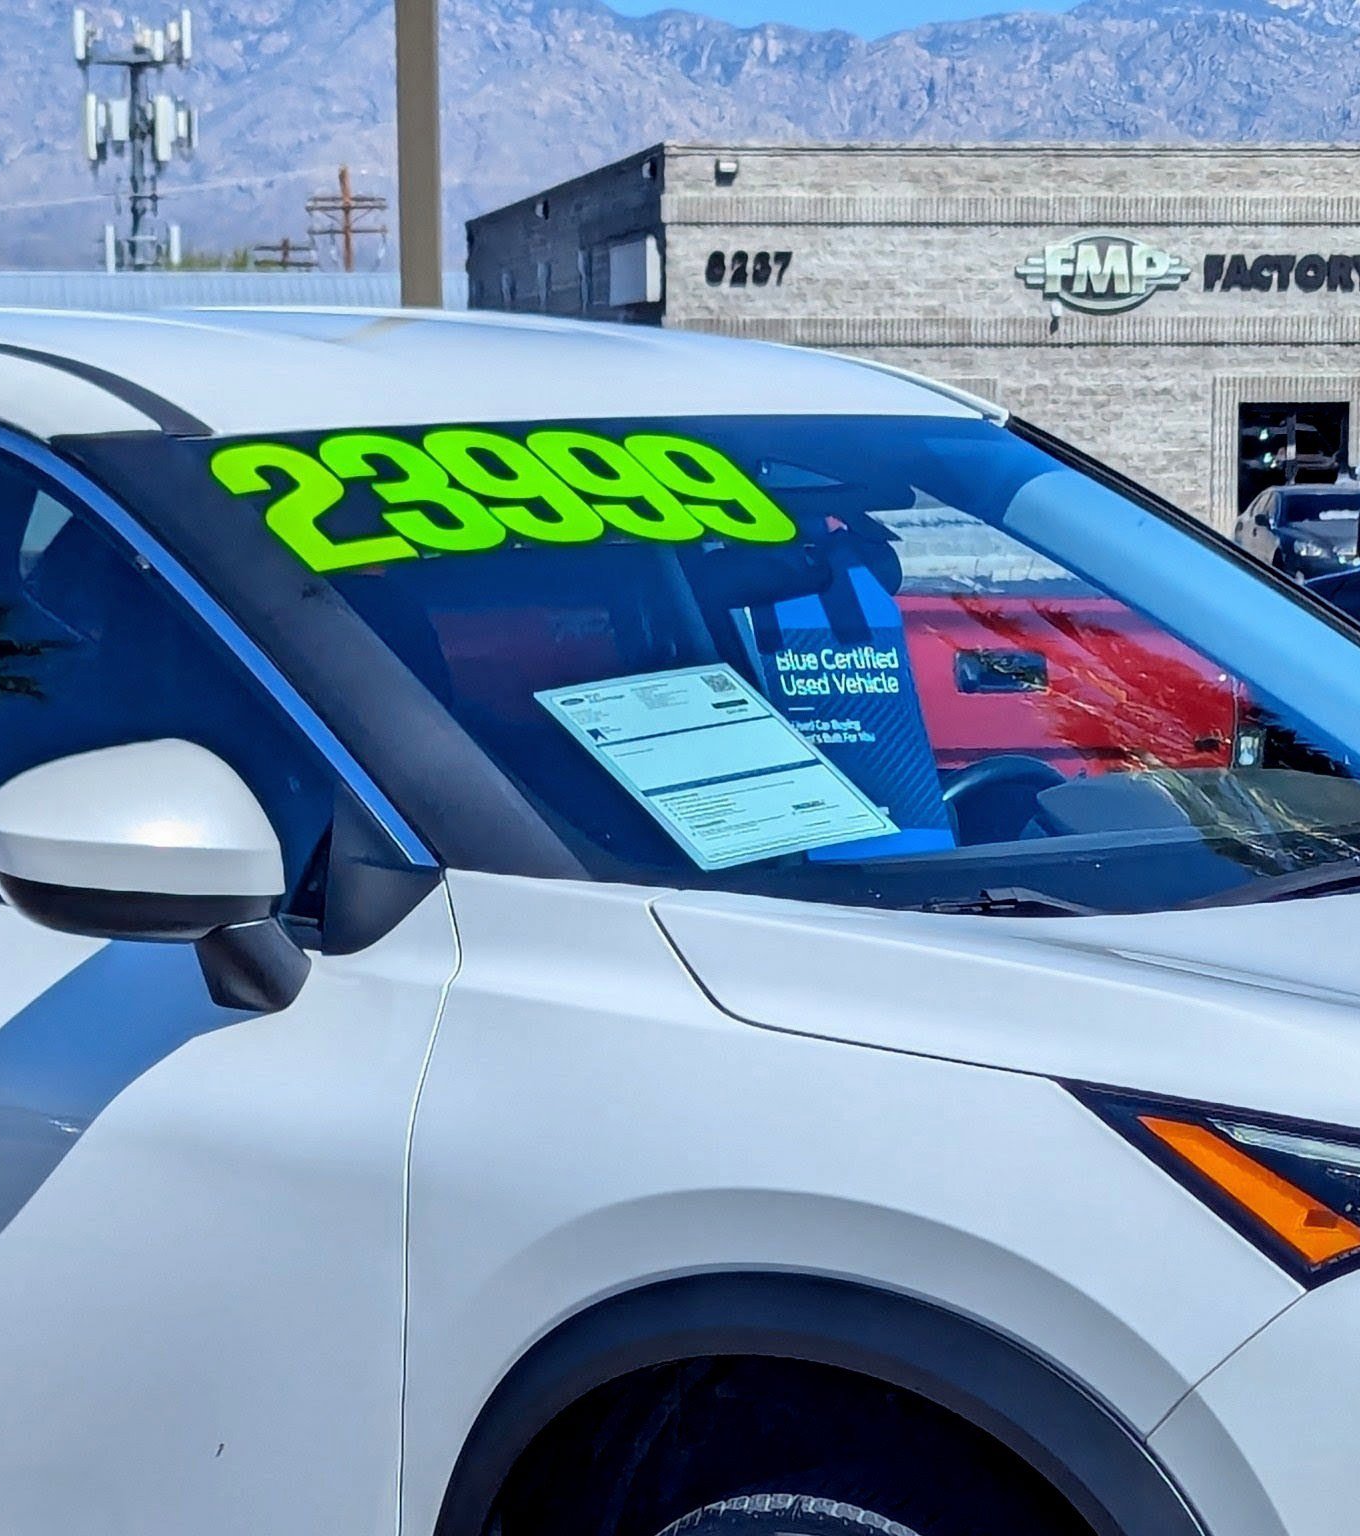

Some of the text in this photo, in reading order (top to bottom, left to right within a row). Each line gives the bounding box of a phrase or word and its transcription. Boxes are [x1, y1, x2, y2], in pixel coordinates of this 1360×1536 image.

[1043, 244, 1171, 296] FMP
[208, 427, 798, 573] 23999
[775, 646, 899, 671] Blue Certified
[780, 671, 899, 696] Used Vehicle
